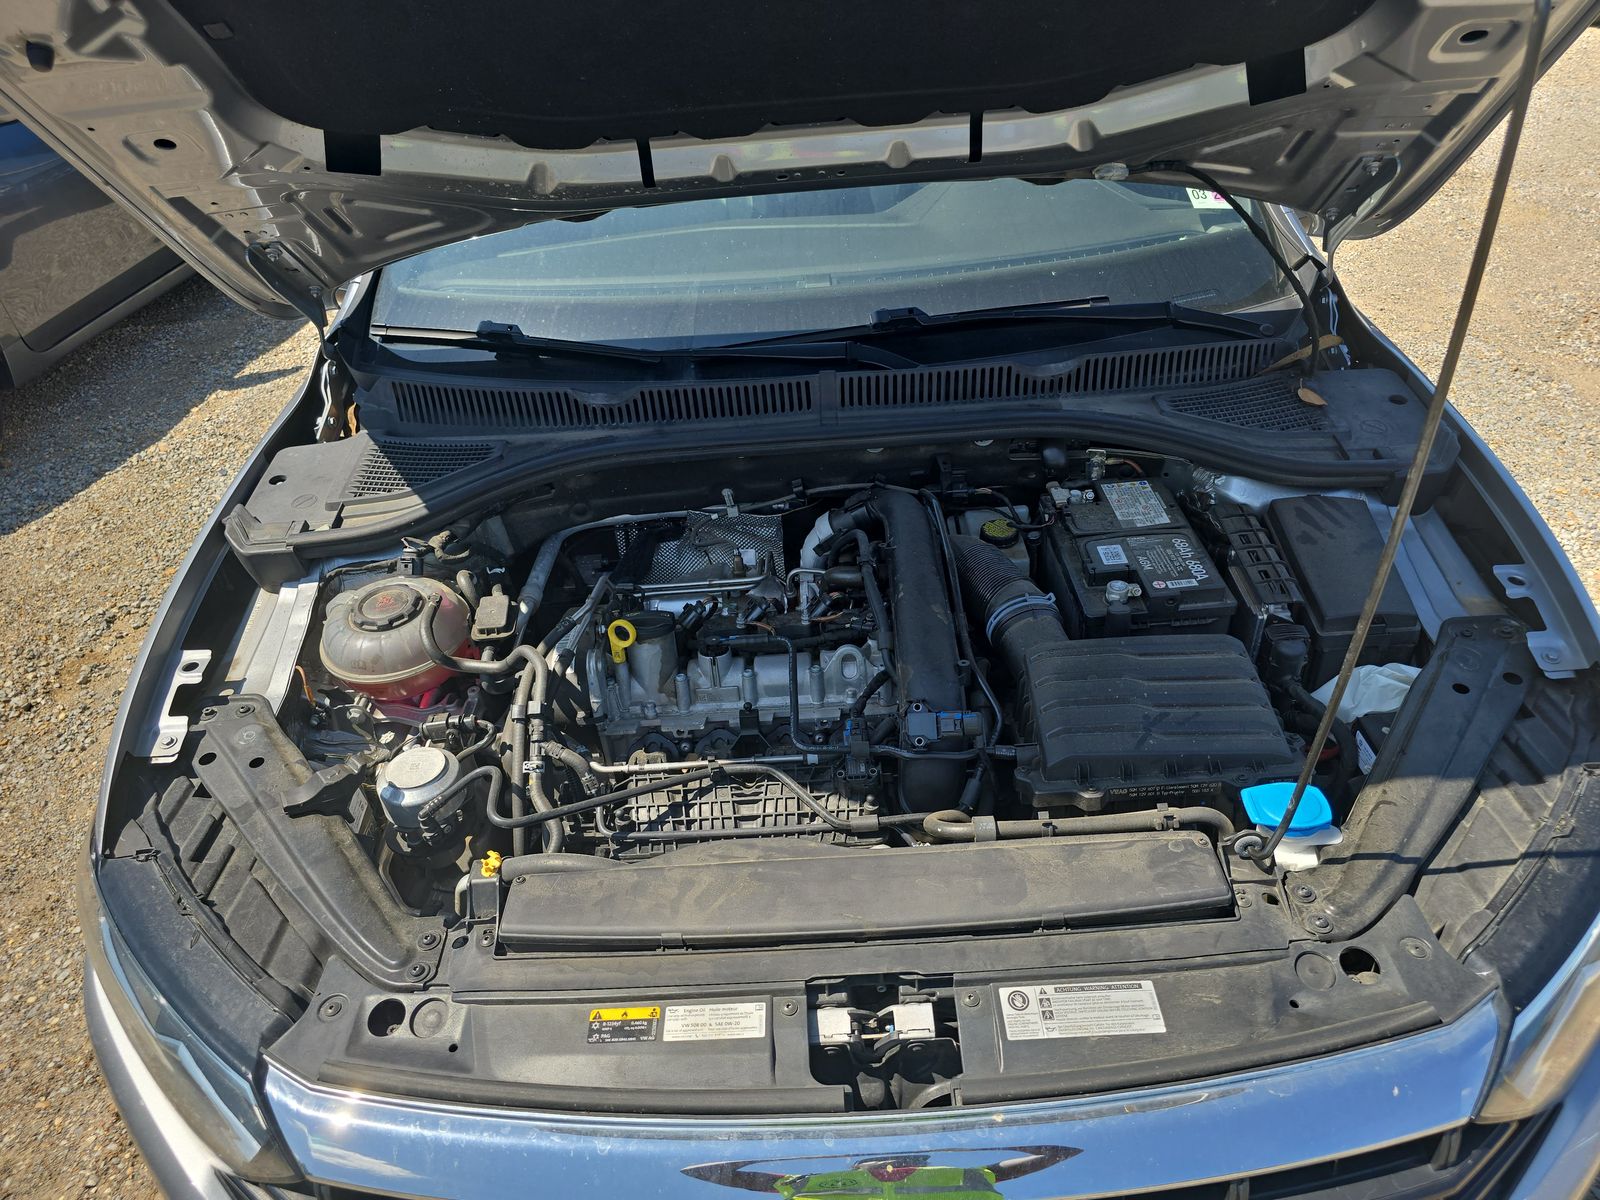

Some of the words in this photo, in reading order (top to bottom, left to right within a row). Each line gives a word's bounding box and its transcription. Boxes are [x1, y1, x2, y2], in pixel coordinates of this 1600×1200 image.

[1192, 189, 1207, 199] 03
[1137, 555, 1154, 571] AGM
[1172, 538, 1196, 559] 68Ah
[1185, 559, 1209, 581] 680A
